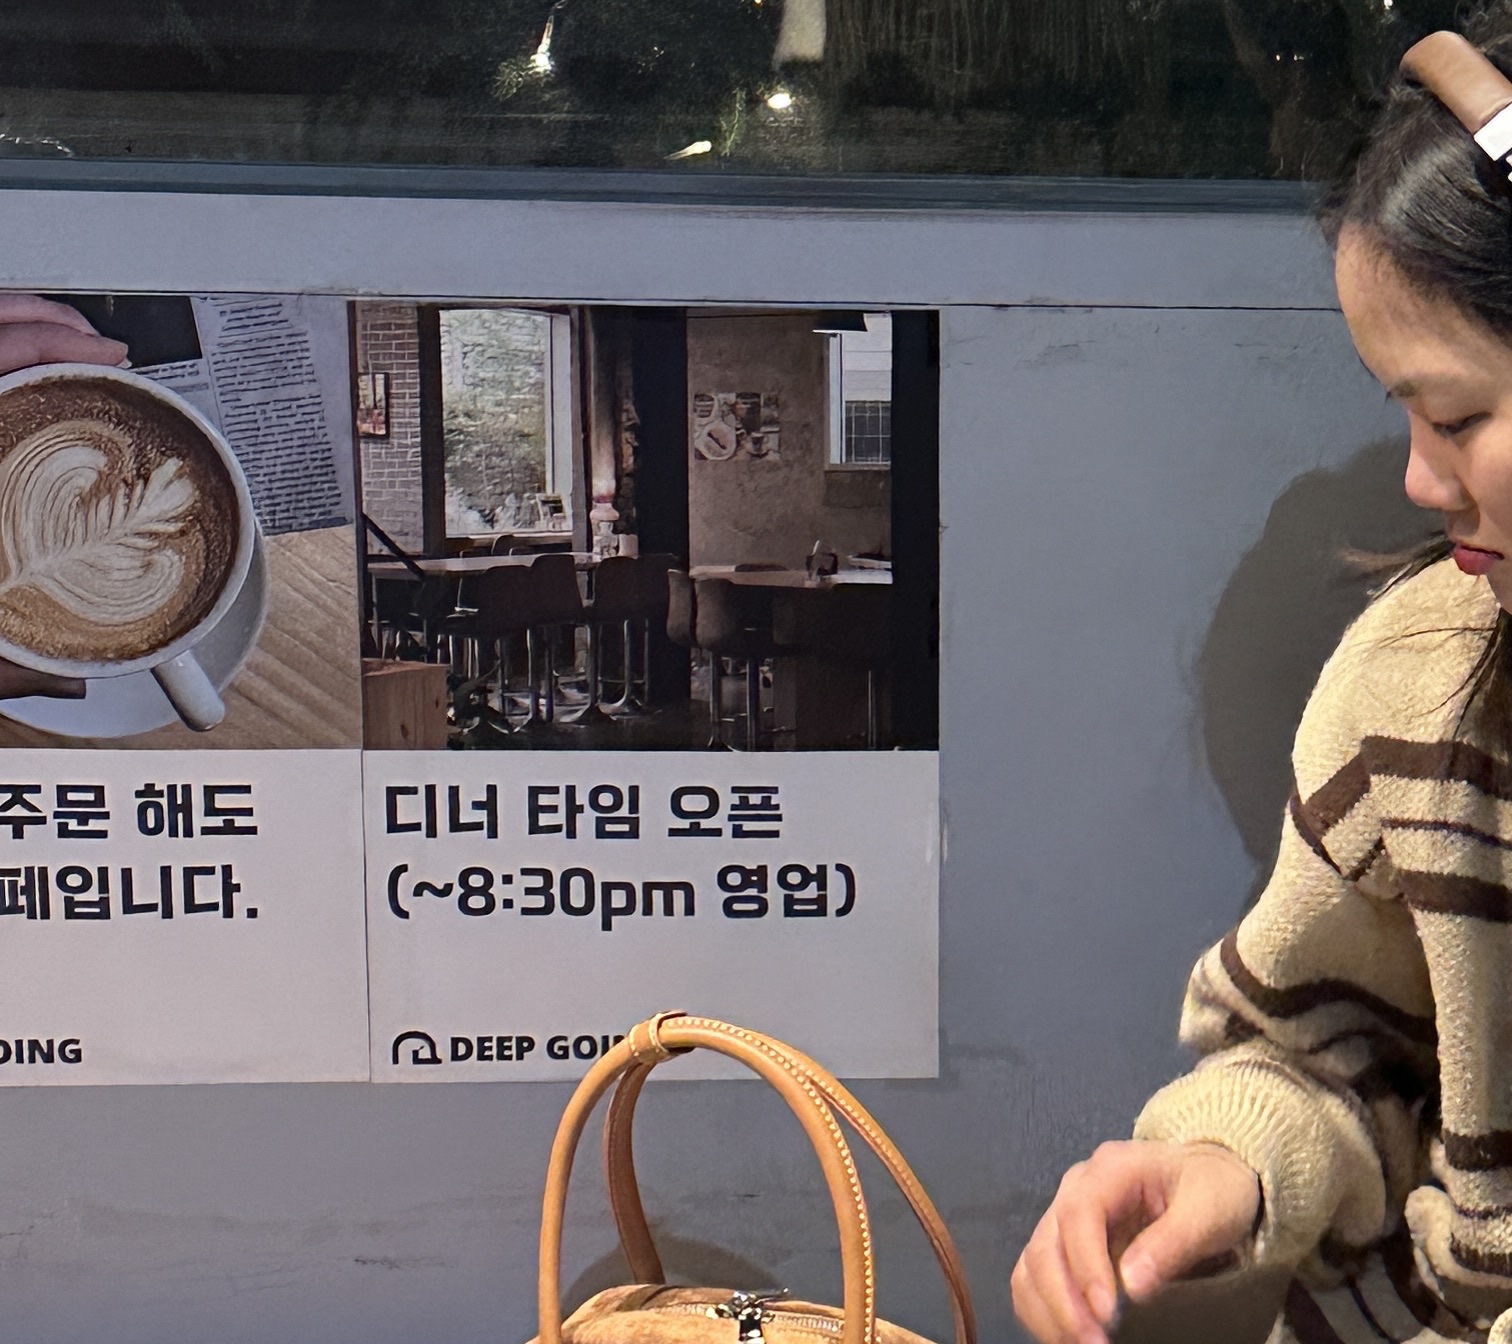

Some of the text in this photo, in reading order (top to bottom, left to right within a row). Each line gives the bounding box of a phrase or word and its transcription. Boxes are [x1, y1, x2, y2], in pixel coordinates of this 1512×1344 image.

[0, 783, 258, 839] 주문 해도
[385, 784, 783, 839] 디너 타임 오픈
[0, 864, 258, 919] 페입니다.
[387, 862, 856, 931] (~8:30pm 영업)
[450, 1035, 625, 1061] DEEP GOI
